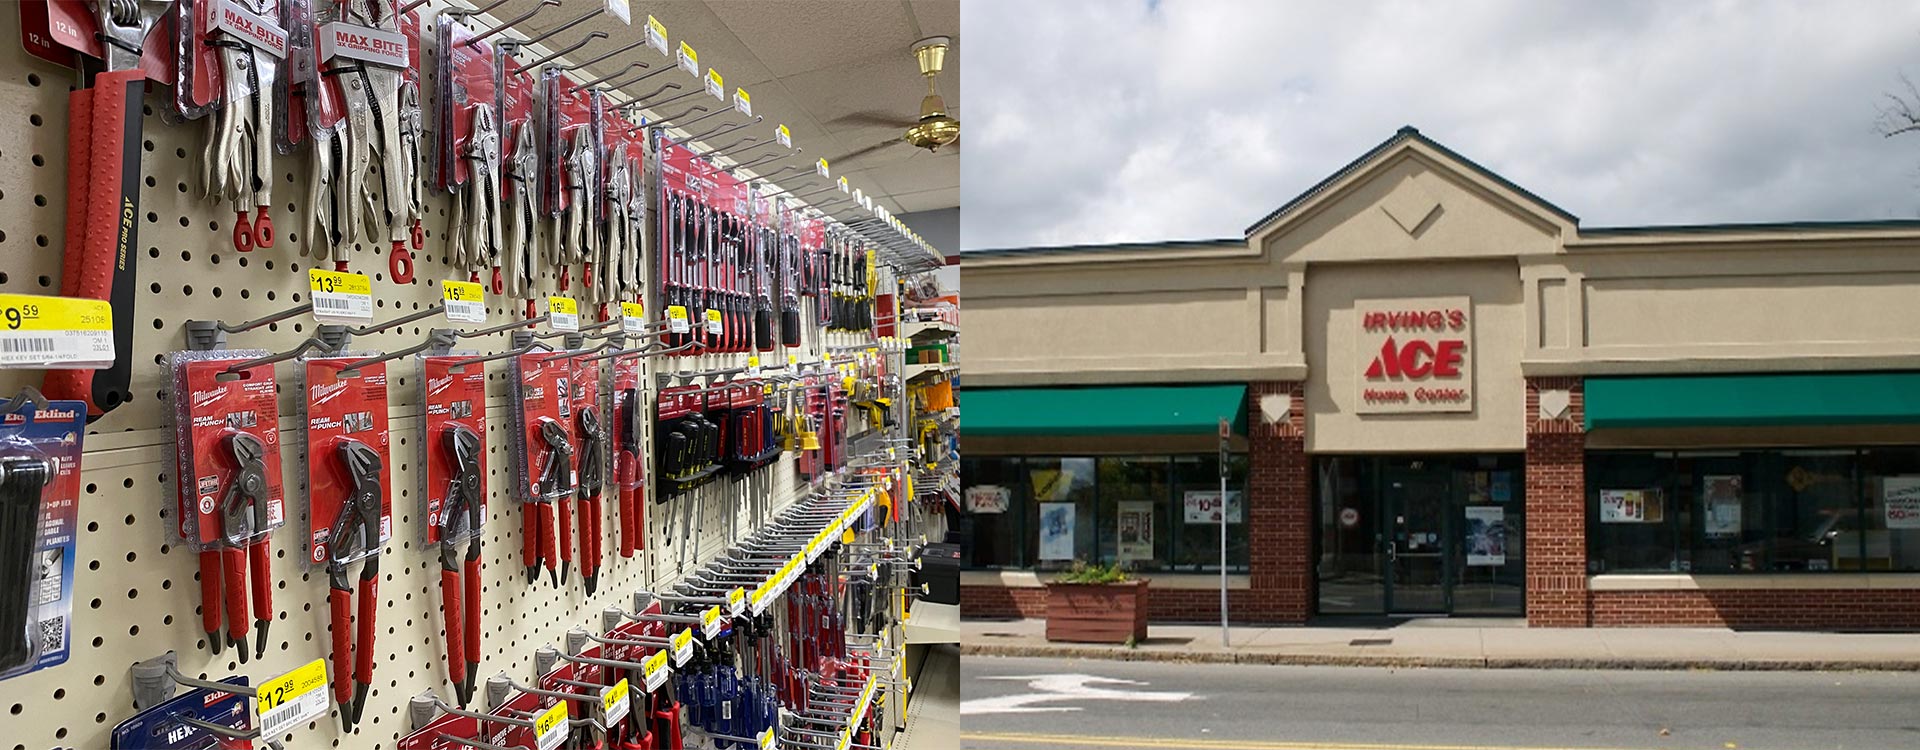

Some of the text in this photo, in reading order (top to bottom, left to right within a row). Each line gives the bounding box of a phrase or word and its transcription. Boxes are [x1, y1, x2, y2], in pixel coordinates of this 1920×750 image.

[55, 20, 77, 37] 12 in
[224, 9, 284, 46] MAX BITE
[224, 19, 284, 51] 3X GRIPPING FORCE
[28, 32, 50, 48] 12 in
[336, 31, 404, 53] MAX BITE
[347, 42, 381, 55] GRIPPING
[381, 48, 403, 58] FORCE
[118, 195, 135, 271] ACE PRO SERIES
[1363, 308, 1466, 330] IRVING'S
[1363, 335, 1465, 379] ACE
[191, 386, 228, 405] Milwaukee
[309, 379, 348, 401] Milwaukee
[1363, 388, 1408, 401] Home
[34, 409, 75, 420] Eklind
[193, 415, 213, 423] REAM
[199, 419, 225, 427] PUNCH
[310, 417, 331, 425] REAM
[317, 421, 342, 430] PUNCH
